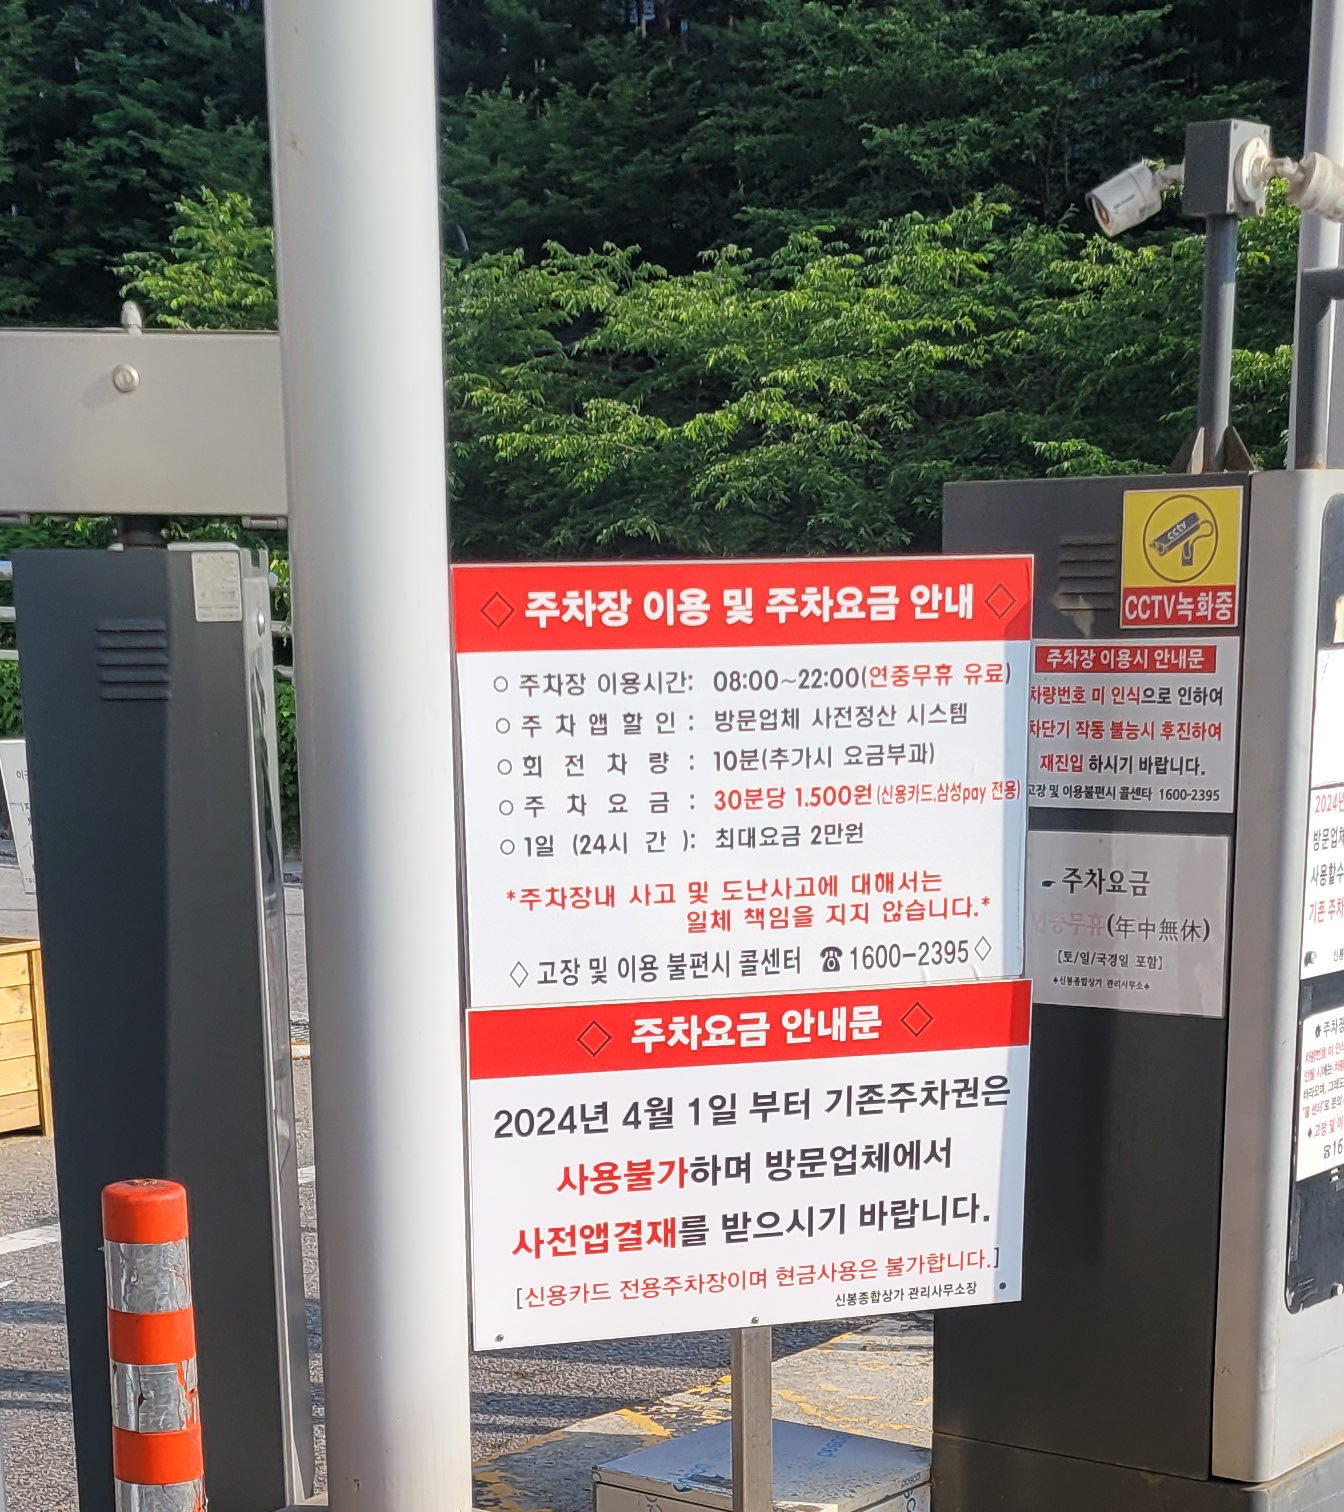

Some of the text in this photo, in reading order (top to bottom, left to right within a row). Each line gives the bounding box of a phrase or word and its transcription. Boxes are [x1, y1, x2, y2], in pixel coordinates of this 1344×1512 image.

[525, 584, 974, 629] 주차장 이용 및 주차요금 안내
[1124, 591, 1233, 621] CCTV녹화중
[1047, 649, 1205, 669] 주차장 이용시 안내문
[519, 672, 586, 696] 주차장
[597, 670, 694, 695] 이용시간:
[963, 663, 1011, 686] 유료)
[1030, 685, 1223, 706] 차량번호 미 인식으로 인하여
[714, 708, 800, 732] 방문업체
[812, 705, 897, 729] 사전정산
[907, 703, 968, 727] 시스템
[1030, 719, 1222, 741] 차단기 작동 불능시 후진하여
[713, 747, 833, 772] 10분(추가시
[843, 742, 935, 767] 요금부과)
[1040, 754, 1206, 776] 재진입 하시기 바랍니다.
[714, 788, 786, 811] 30분당
[992, 779, 1021, 801] 전용)
[1049, 784, 1059, 798] 및
[1063, 785, 1116, 800] 이용불편시
[1159, 788, 1220, 801] 1600-2395
[525, 835, 555, 857] 1일
[715, 826, 801, 850] 최대요금
[811, 822, 864, 846] 2만원
[629, 882, 675, 905] 사고
[688, 881, 710, 906] 및
[722, 875, 838, 902] 도난사고에
[851, 870, 943, 895] 대해서는
[1062, 867, 1151, 897] 주차요금
[687, 910, 731, 933] 일체
[744, 906, 813, 930] 책임을
[826, 904, 870, 925] 지지
[537, 941, 969, 986] 고장 및 이용 불편시 콜센터 1600-2395
[631, 1005, 883, 1054] 주차요금 안내문
[1323, 1017, 1344, 1037] 주차장
[495, 1074, 1010, 1140] 2024년 4월 1일 부터 기존주차권은
[557, 1137, 952, 1196] 사용불가하며 방문업체에서
[512, 1193, 990, 1258] 사전앱결재를 받으시기 바랍니다.
[619, 1269, 767, 1301] 전용주차장이며
[776, 1256, 878, 1289] 현금사용은
[834, 1280, 977, 1308] 신봉종합상가 관리사무소장
